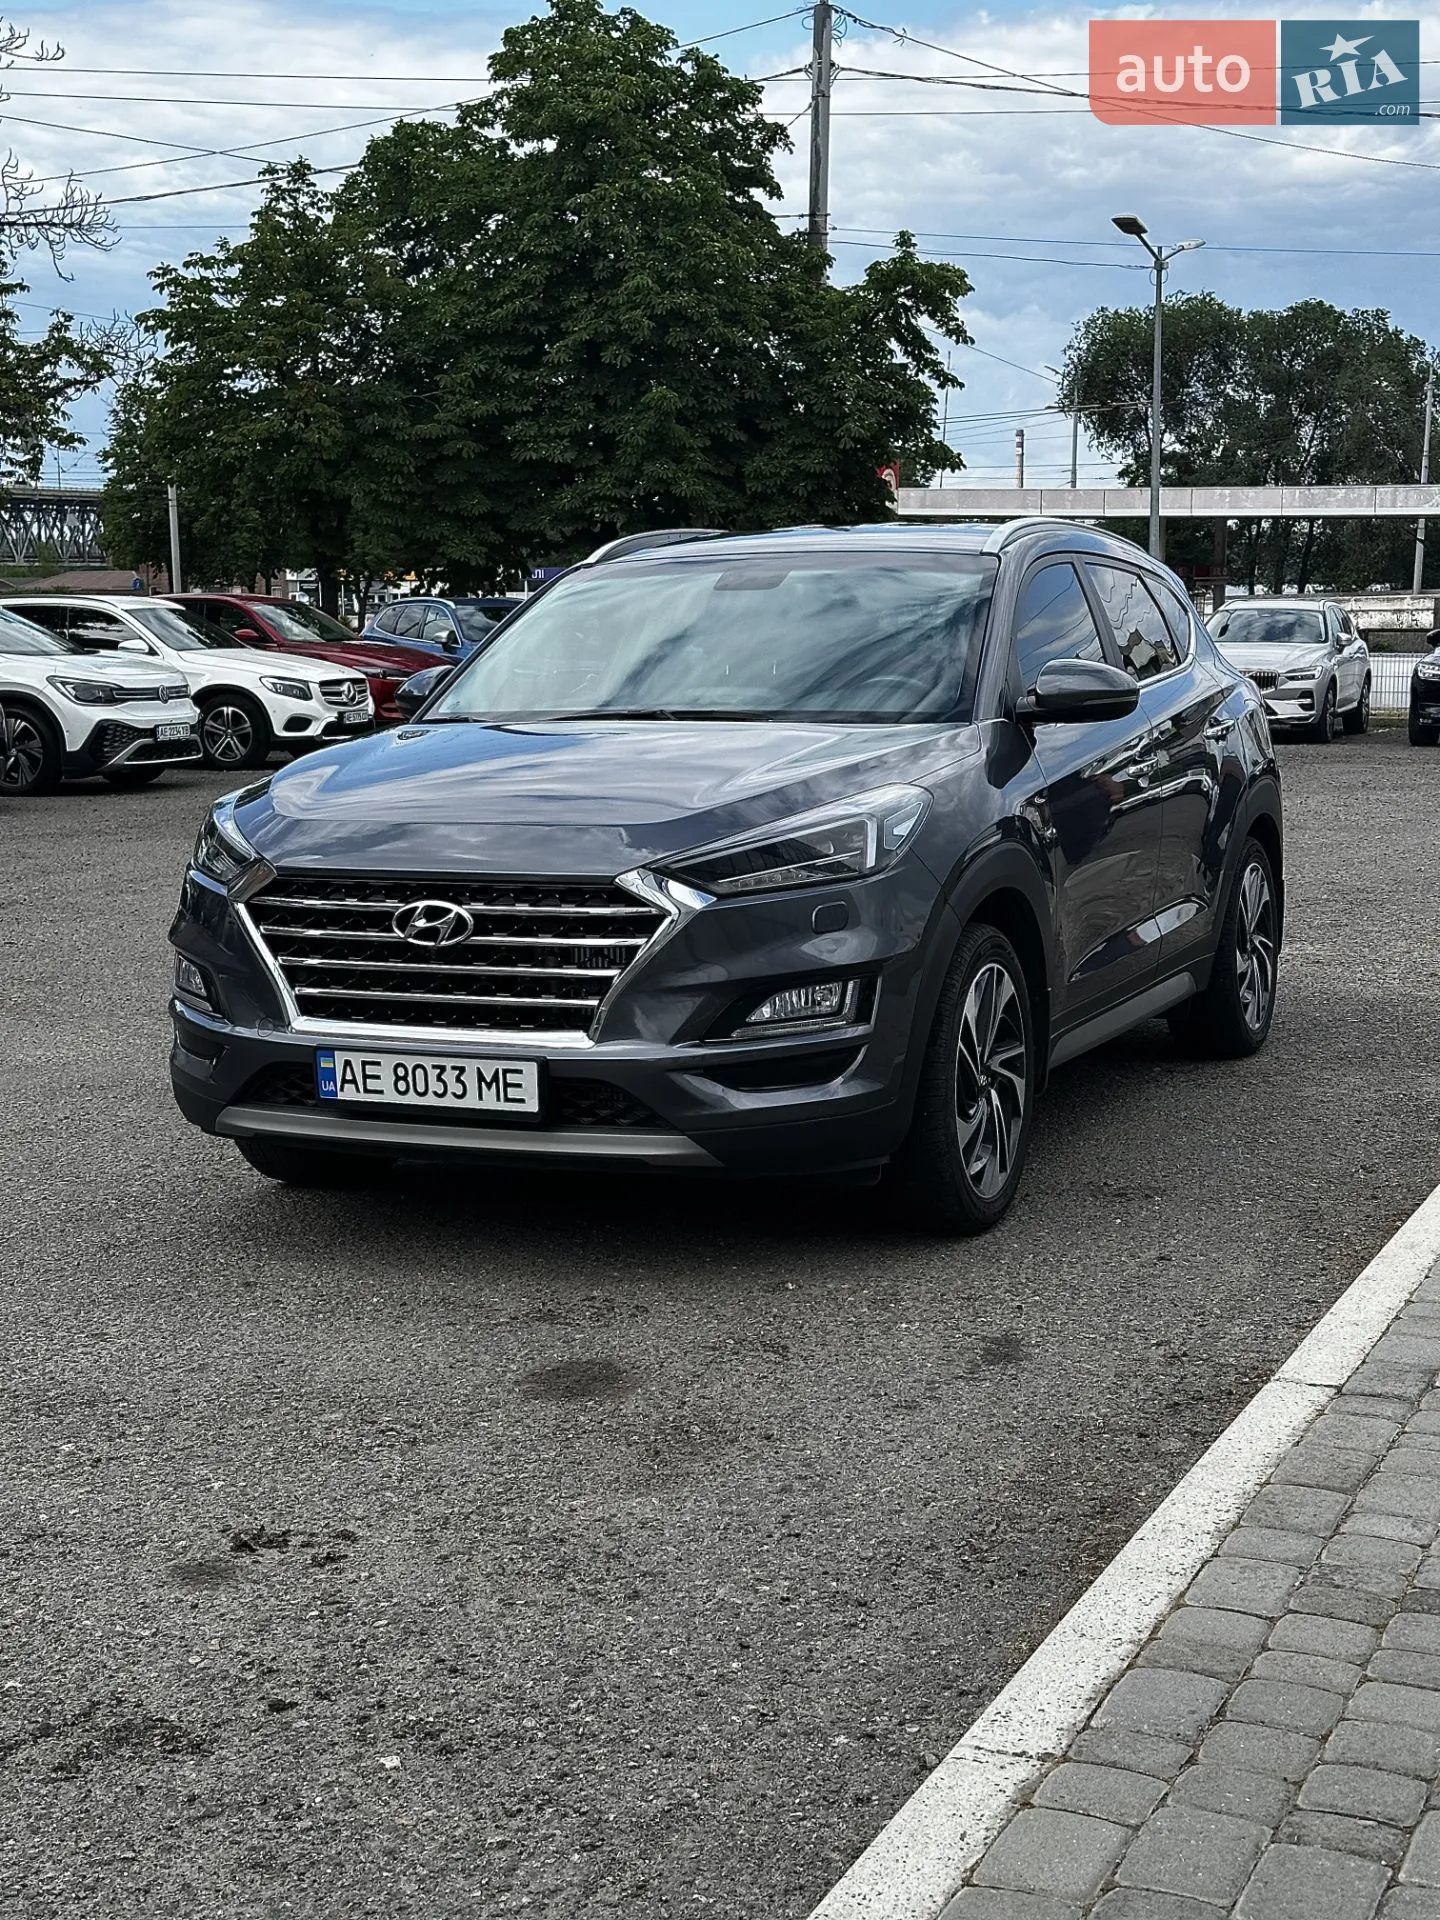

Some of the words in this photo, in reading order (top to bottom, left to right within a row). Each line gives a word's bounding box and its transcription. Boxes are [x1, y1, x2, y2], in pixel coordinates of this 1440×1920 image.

[321, 1080, 336, 1092] UA
[339, 1058, 385, 1095] AE
[392, 1061, 468, 1100] 8033
[476, 1066, 527, 1104] ME
